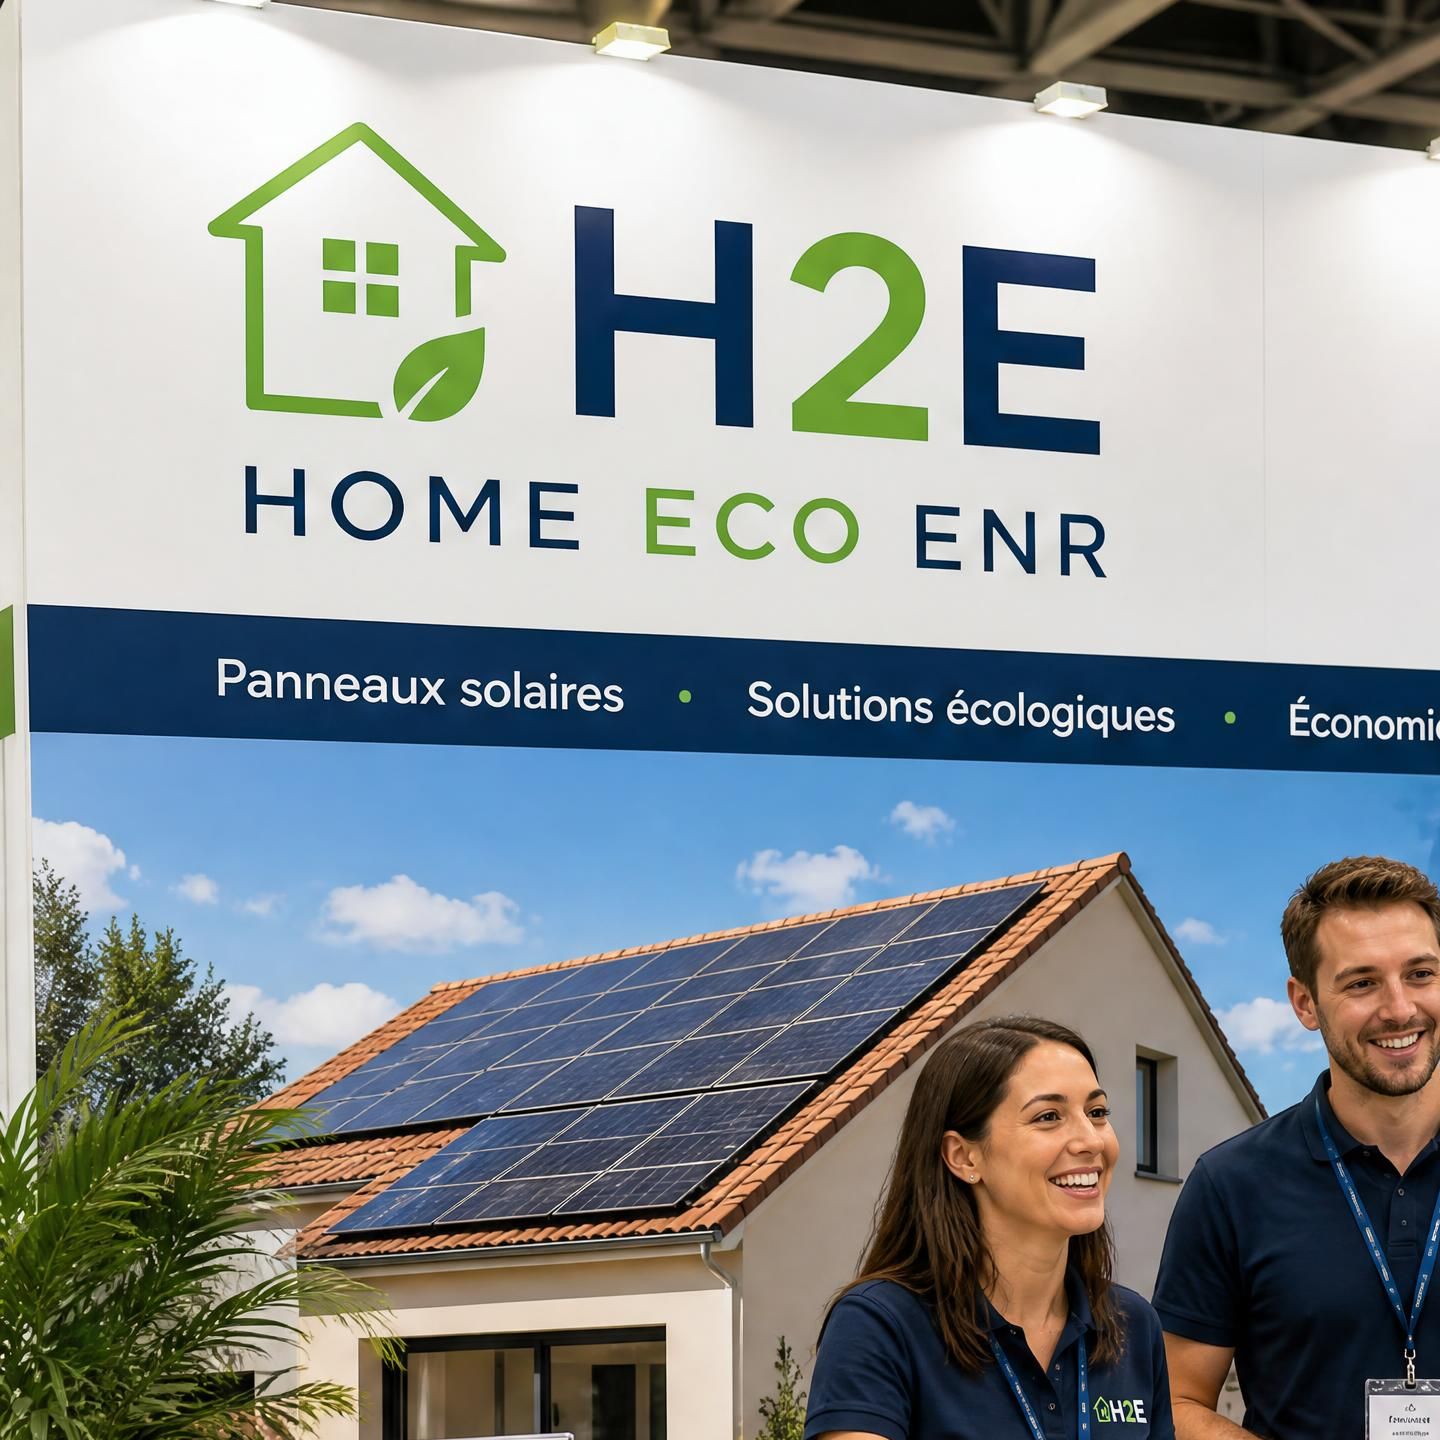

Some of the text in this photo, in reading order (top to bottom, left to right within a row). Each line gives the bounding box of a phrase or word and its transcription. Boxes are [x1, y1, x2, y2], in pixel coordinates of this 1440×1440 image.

[575, 205, 1100, 455] H2E
[245, 466, 1106, 578] HOME ECO ENR
[218, 658, 445, 705] Panneaux
[461, 671, 624, 712] solaires
[748, 681, 933, 723] Solutions
[947, 690, 1175, 738] écologiques
[1109, 1400, 1147, 1423] H2E
